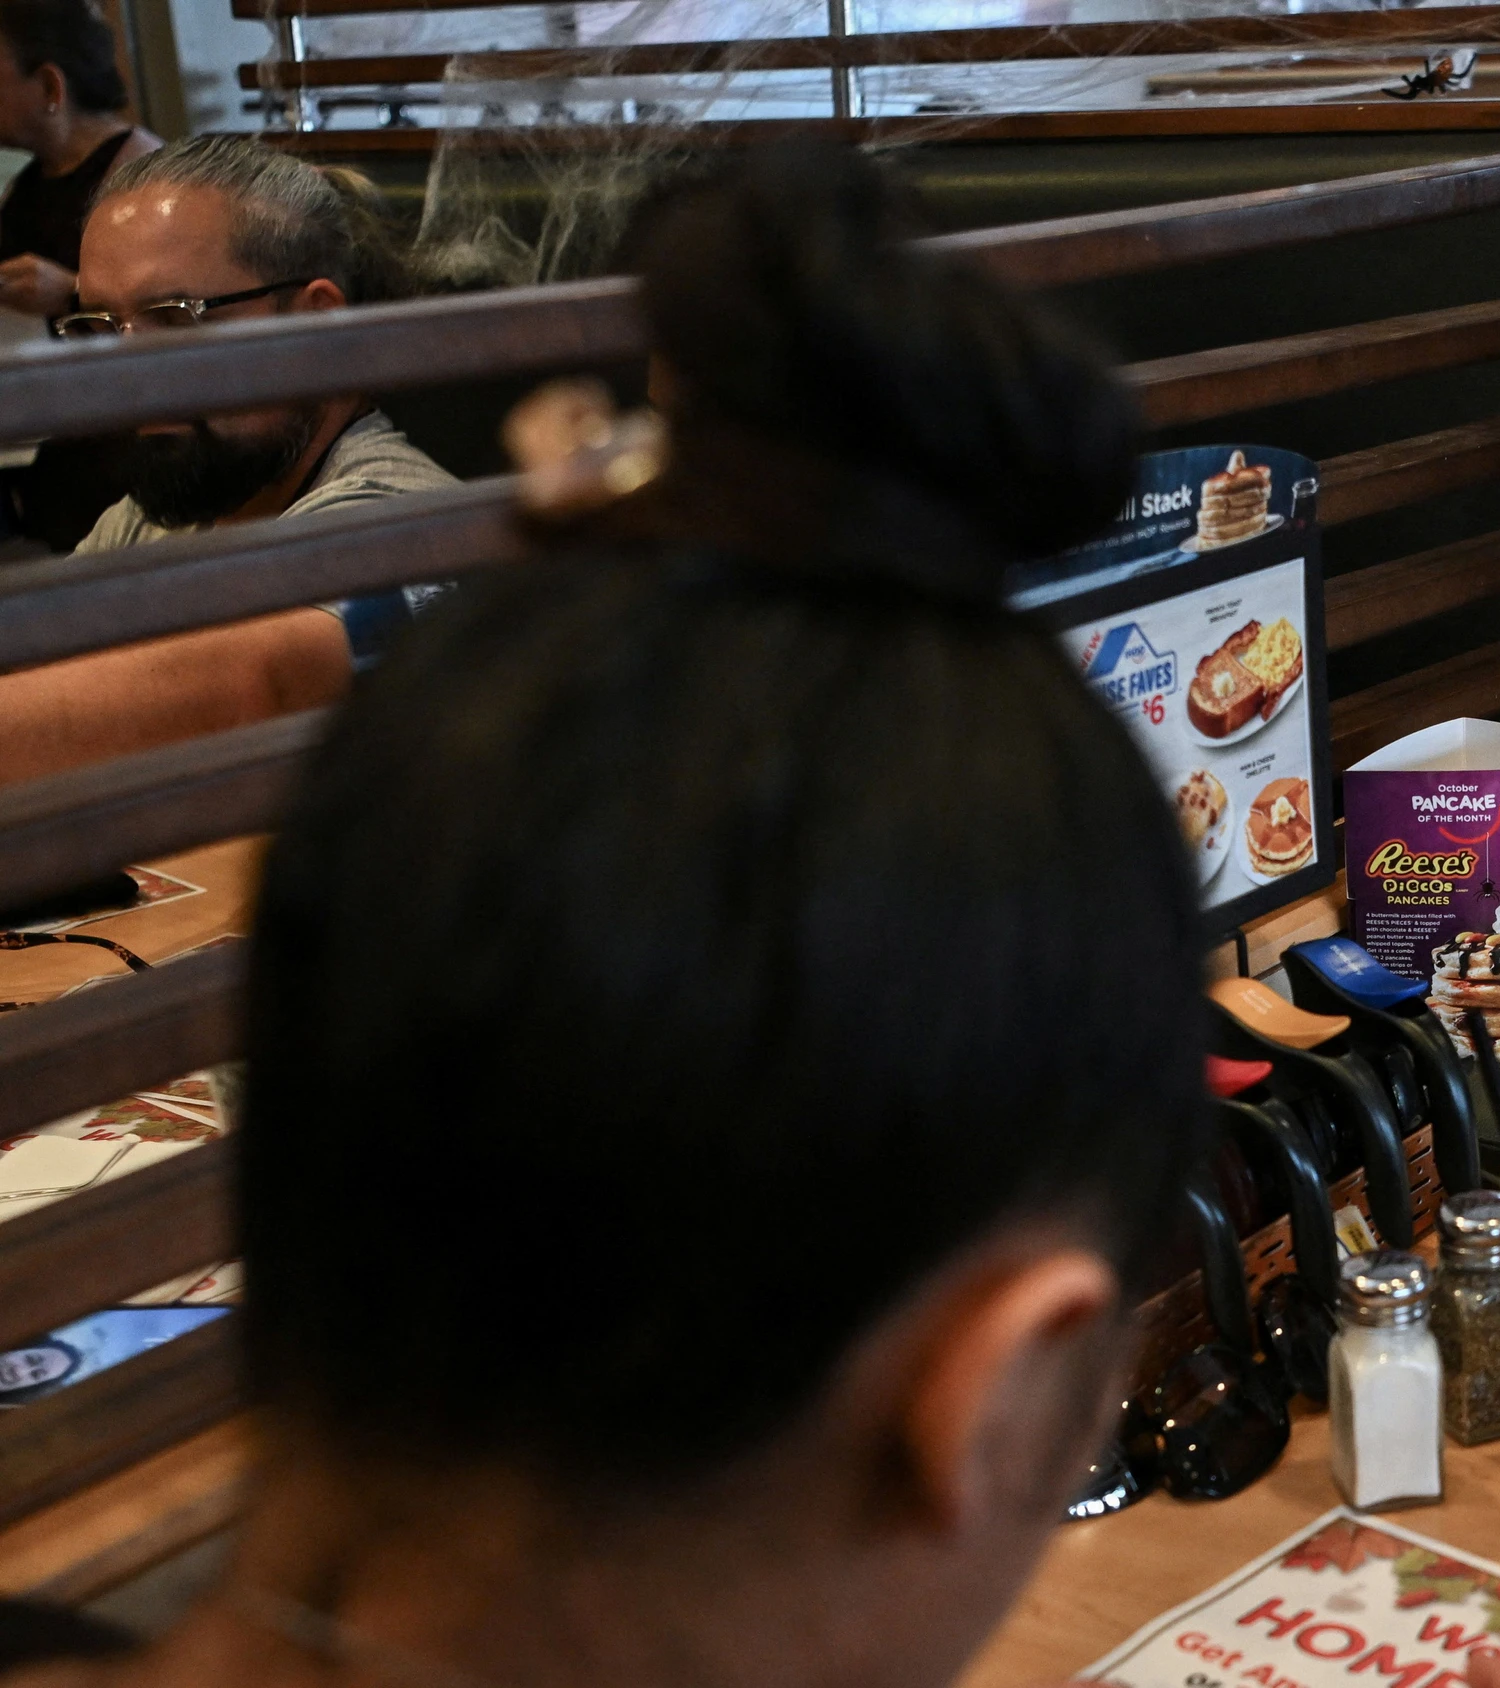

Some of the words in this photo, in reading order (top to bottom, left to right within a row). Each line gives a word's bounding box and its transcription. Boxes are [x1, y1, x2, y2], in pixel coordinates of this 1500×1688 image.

[1141, 484, 1193, 518] Stack
[1103, 677, 1126, 704] SE
[1129, 662, 1172, 698] FAVES
[1142, 693, 1165, 725] $6
[1411, 794, 1496, 812] PANCAKE
[1438, 784, 1478, 793] October
[1417, 815, 1431, 823] OF
[1434, 814, 1453, 823] THE
[1455, 814, 1491, 822] MONTH
[1367, 841, 1478, 876] Reese's
[1387, 895, 1450, 905] PANCAKES
[1175, 1631, 1243, 1669] Get
